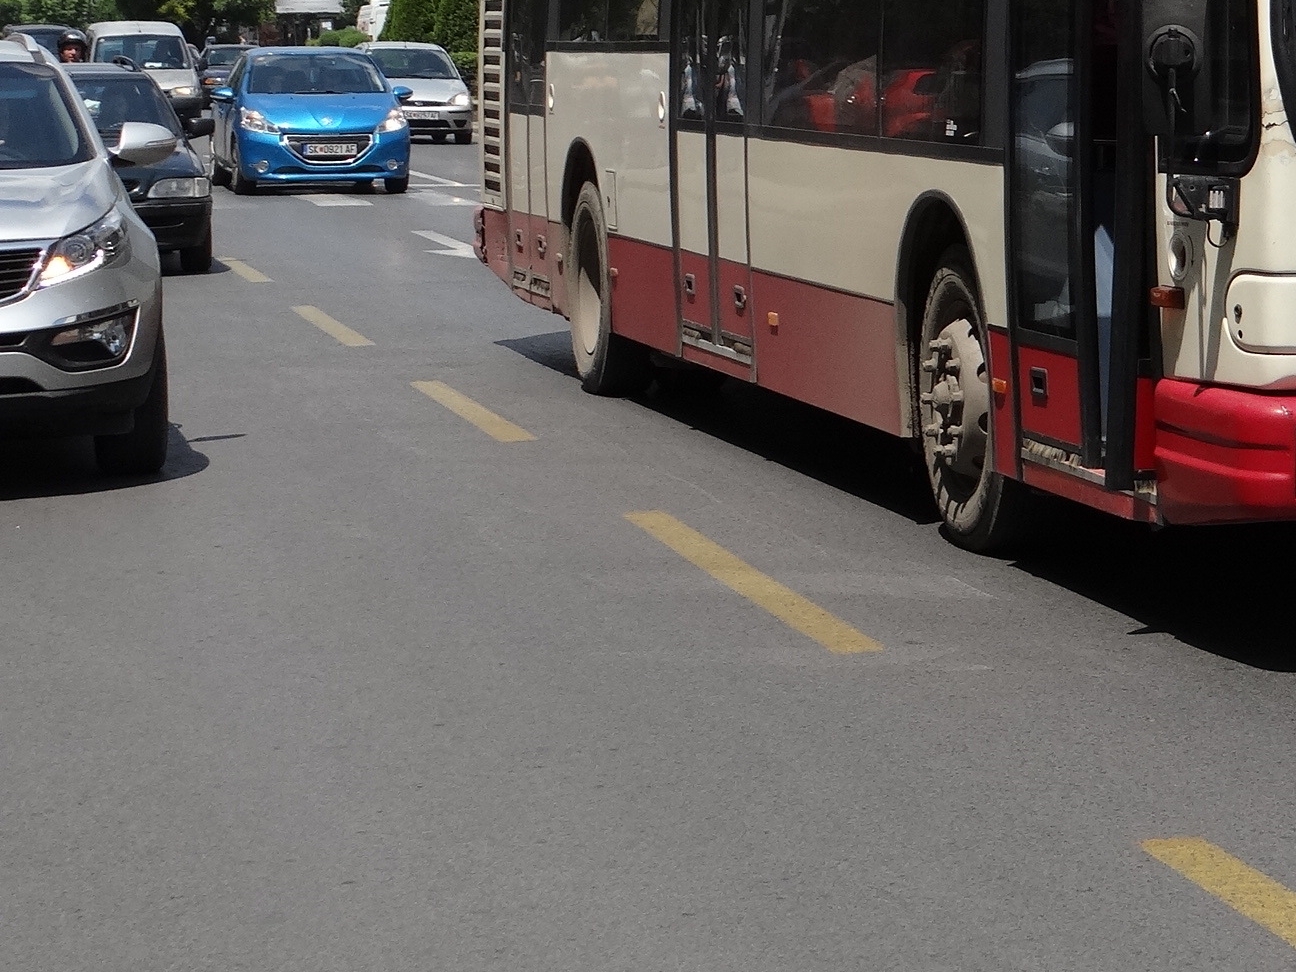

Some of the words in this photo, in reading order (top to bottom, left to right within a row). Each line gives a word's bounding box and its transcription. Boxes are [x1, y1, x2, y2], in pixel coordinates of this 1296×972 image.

[308, 145, 318, 154] SK
[323, 145, 343, 154] 0921
[345, 145, 355, 154] AF
